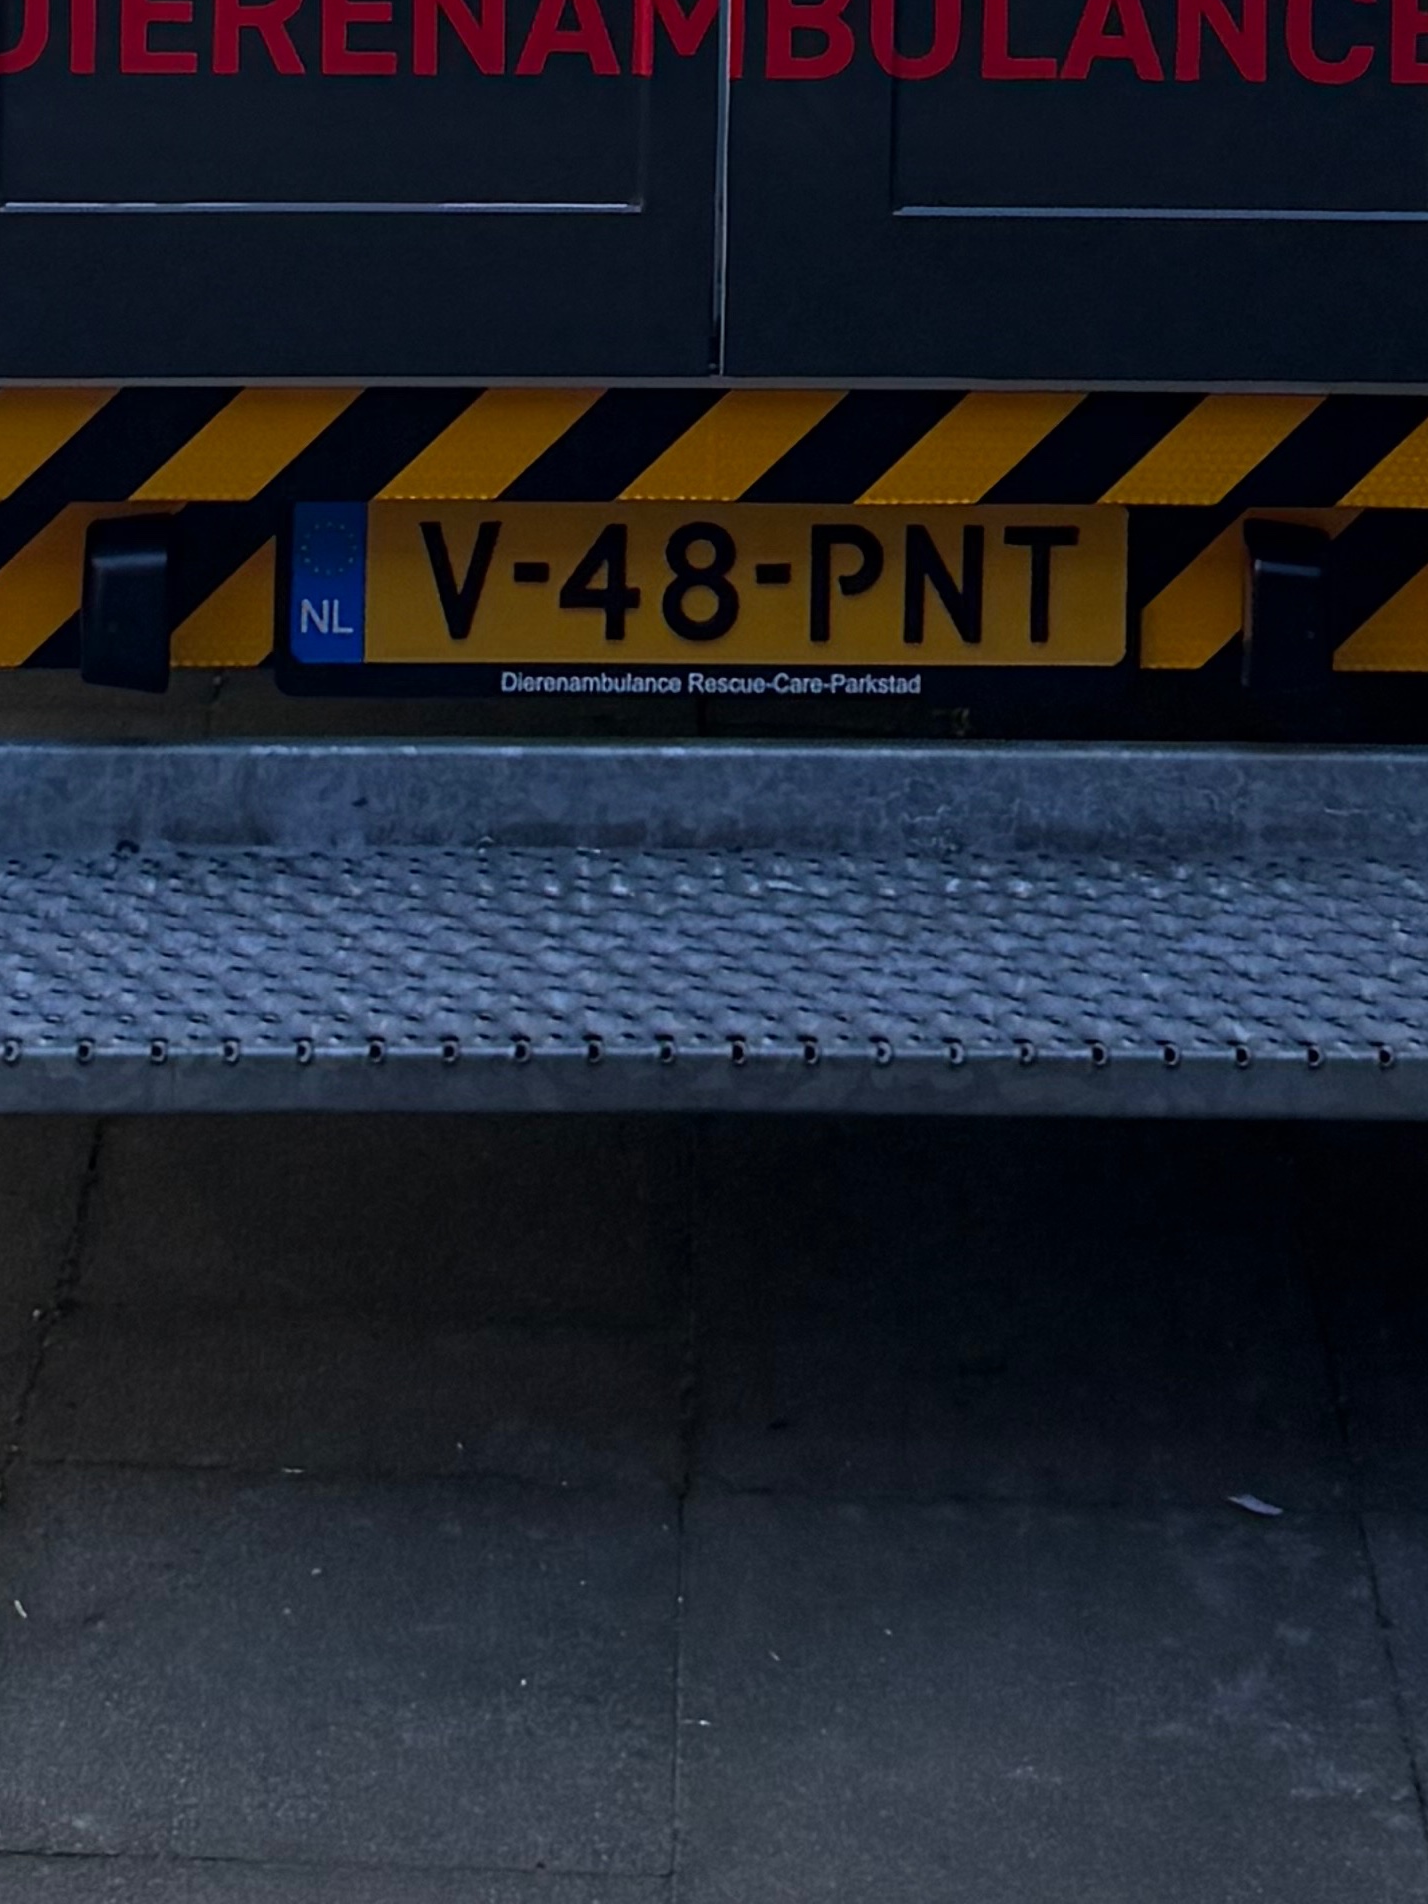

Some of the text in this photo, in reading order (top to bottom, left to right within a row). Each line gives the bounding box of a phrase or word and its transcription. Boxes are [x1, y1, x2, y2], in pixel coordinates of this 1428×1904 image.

[298, 520, 1080, 644] NL V-48-PNT
[501, 671, 921, 694] Dierenambulance Rescue-Care-Parkstad
